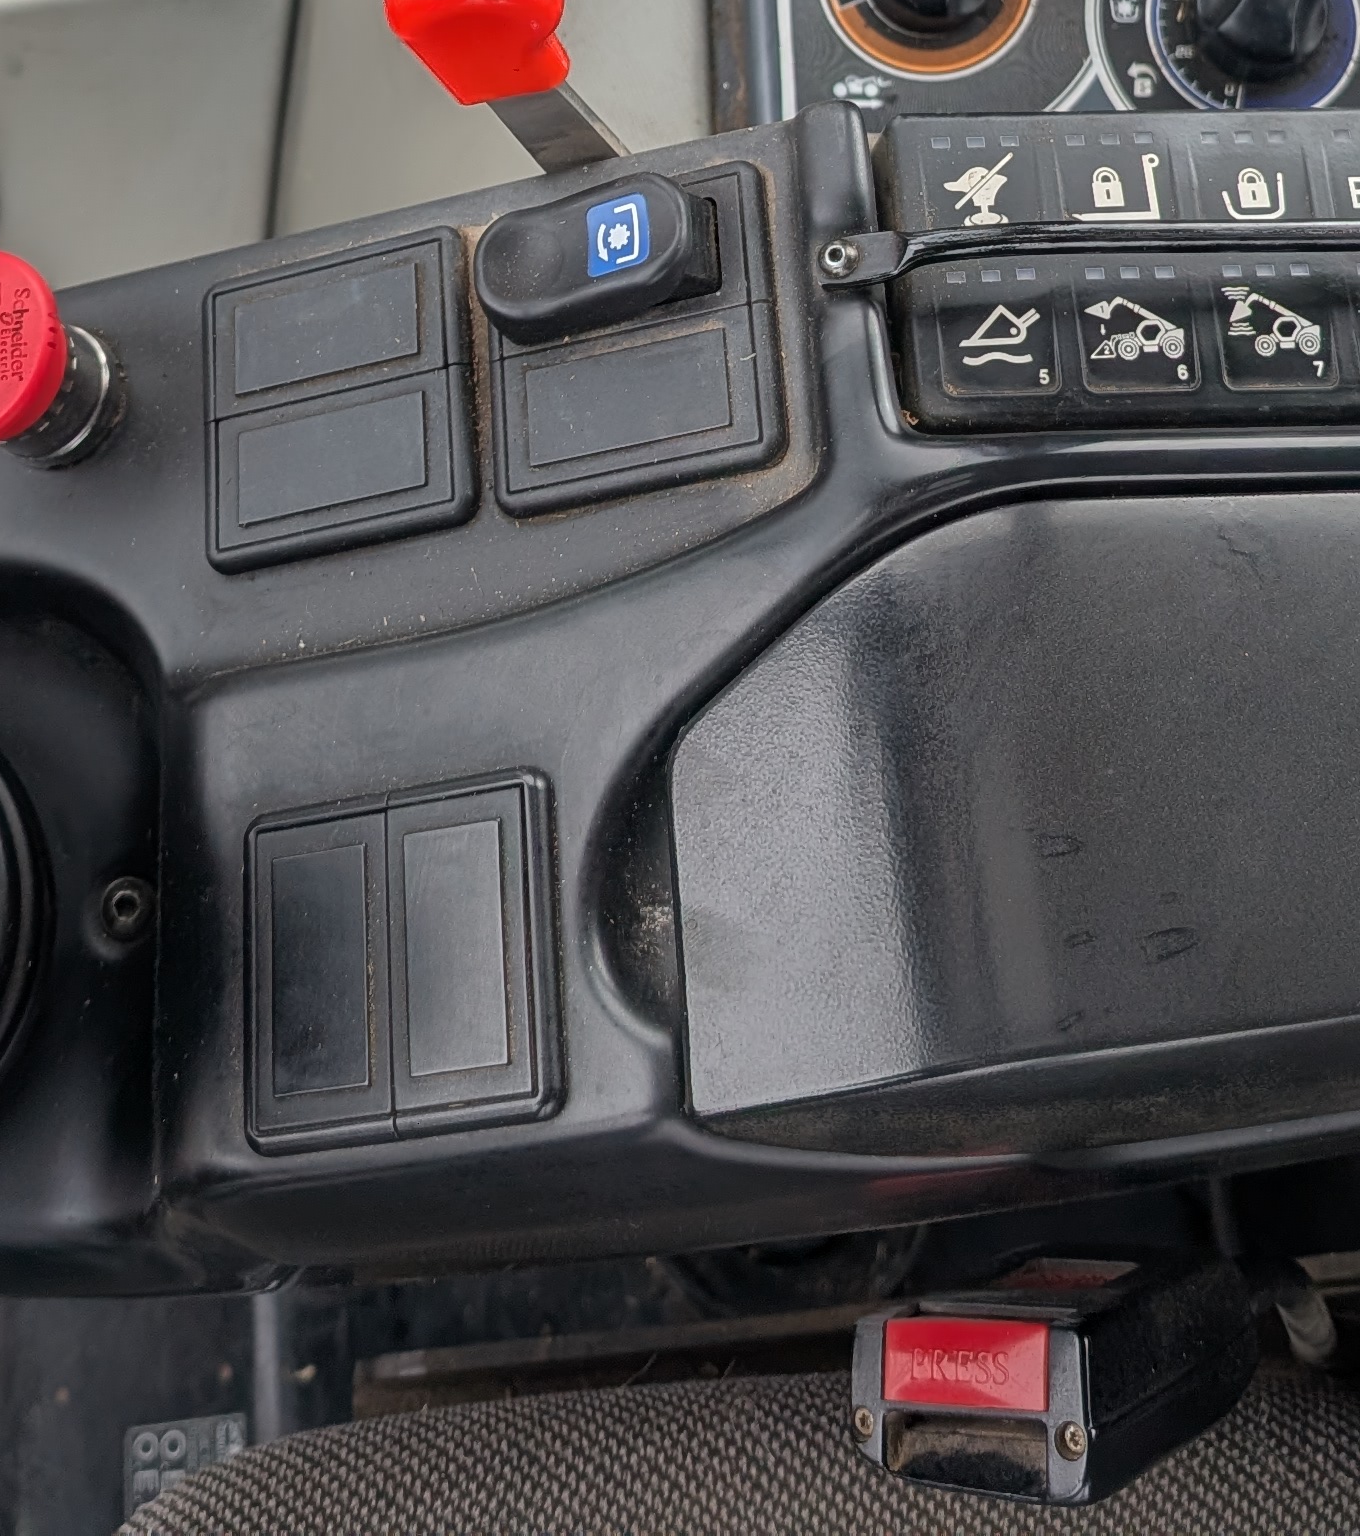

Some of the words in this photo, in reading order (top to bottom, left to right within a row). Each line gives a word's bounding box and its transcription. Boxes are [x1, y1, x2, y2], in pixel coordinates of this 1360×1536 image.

[11, 287, 31, 382] Schneider
[0, 328, 11, 381] Electric
[1039, 368, 1050, 384] 5
[1176, 364, 1189, 380] 6
[1312, 360, 1324, 377] 7
[910, 1347, 1010, 1385] PRESS
